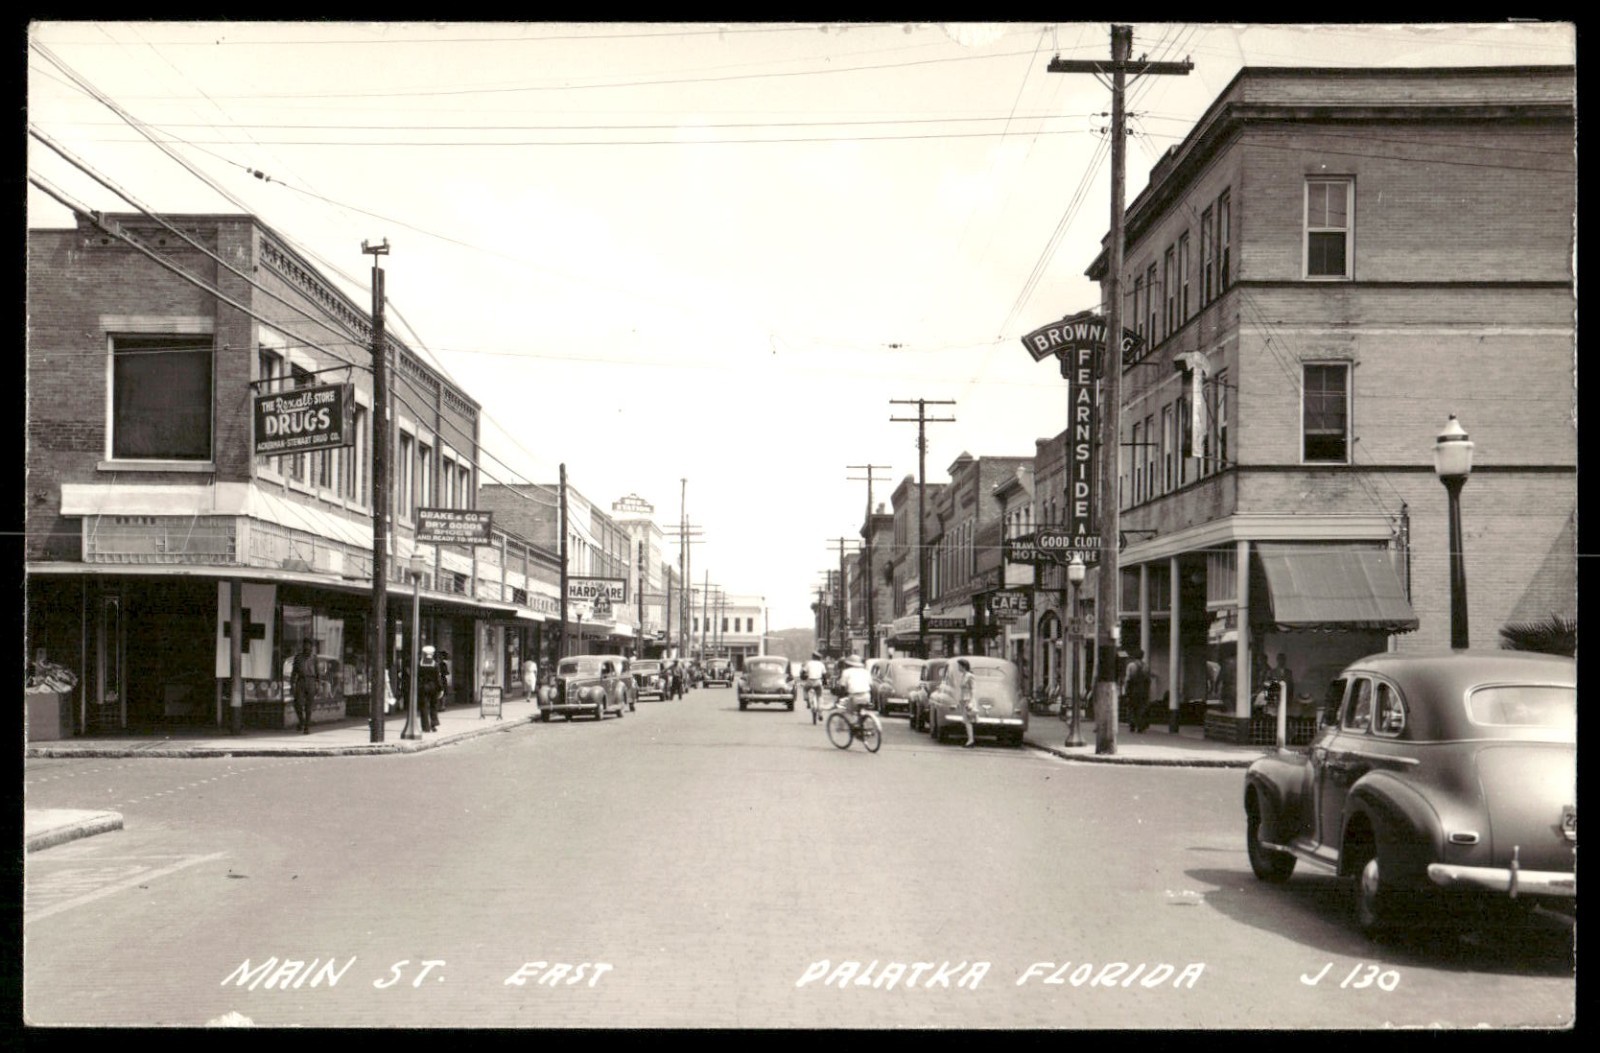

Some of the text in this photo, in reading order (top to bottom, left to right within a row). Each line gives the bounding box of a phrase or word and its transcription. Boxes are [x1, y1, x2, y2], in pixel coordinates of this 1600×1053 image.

[1033, 323, 1134, 352] BROWNIG
[262, 391, 335, 414] THE Rexall STORE
[265, 408, 330, 434] DRUGS
[312, 433, 328, 443] DRUG
[1075, 349, 1091, 518] FEARNSIDE
[420, 511, 454, 520] DRAKE
[449, 522, 482, 530] GOODS
[1079, 523, 1086, 534] A
[1041, 536, 1069, 547] GOOD
[991, 597, 1028, 609] CAFE
